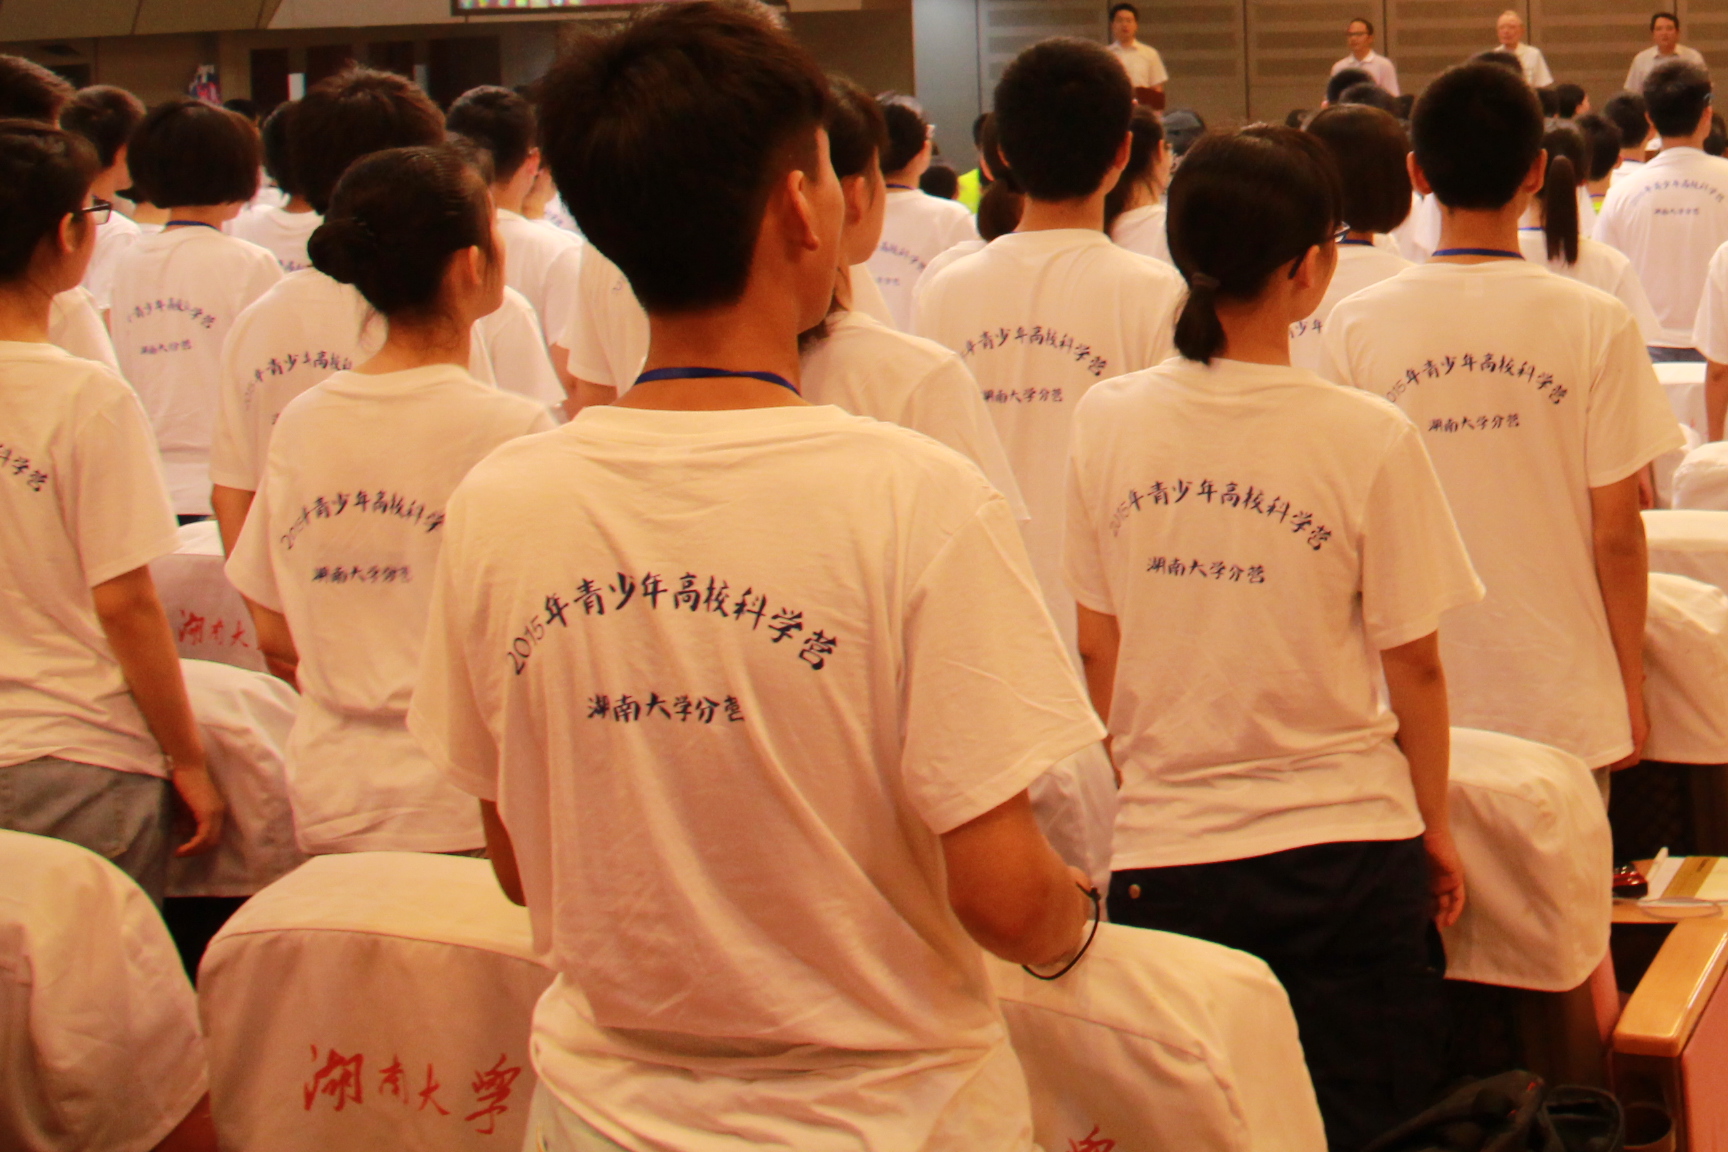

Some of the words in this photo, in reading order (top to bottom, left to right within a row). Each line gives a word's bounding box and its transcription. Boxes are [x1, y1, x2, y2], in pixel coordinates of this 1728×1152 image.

[1384, 352, 1568, 404] 015年青少年高校科学营
[507, 572, 838, 676] 2015年青少年高校科学营
[587, 692, 745, 724] 湖南大学分营
